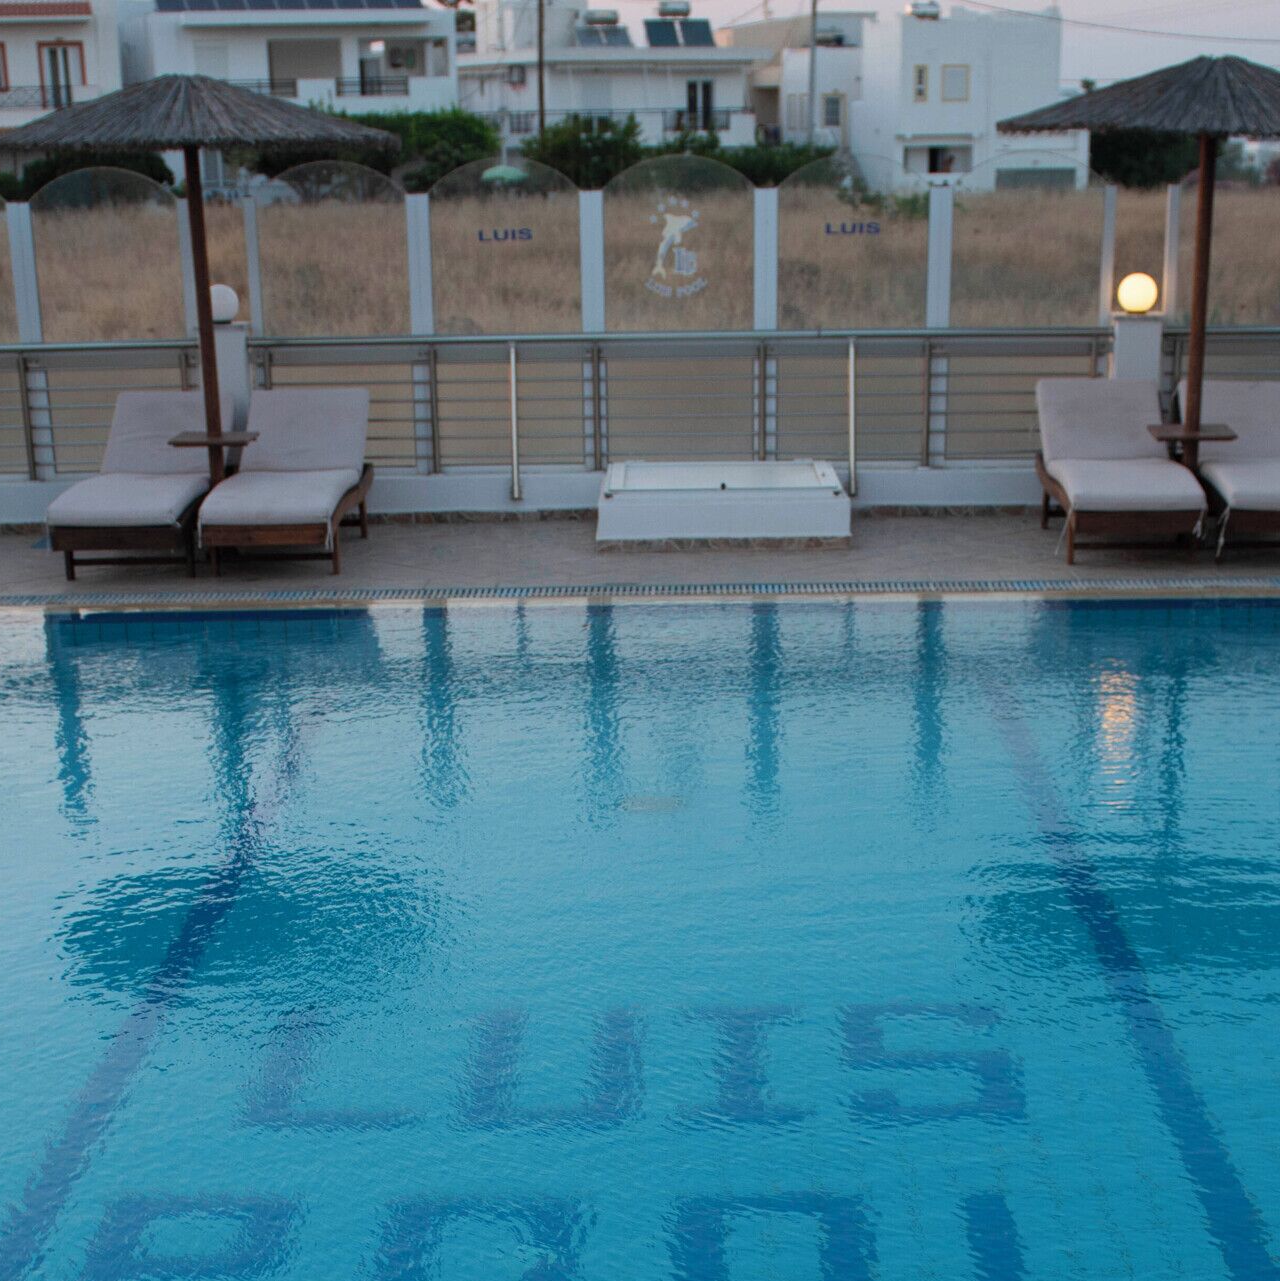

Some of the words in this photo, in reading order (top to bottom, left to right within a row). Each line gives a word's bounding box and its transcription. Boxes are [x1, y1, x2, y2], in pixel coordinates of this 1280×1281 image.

[478, 227, 533, 241] LUIS
[825, 222, 880, 235] LUIS
[242, 1003, 1026, 1128] LUIS
